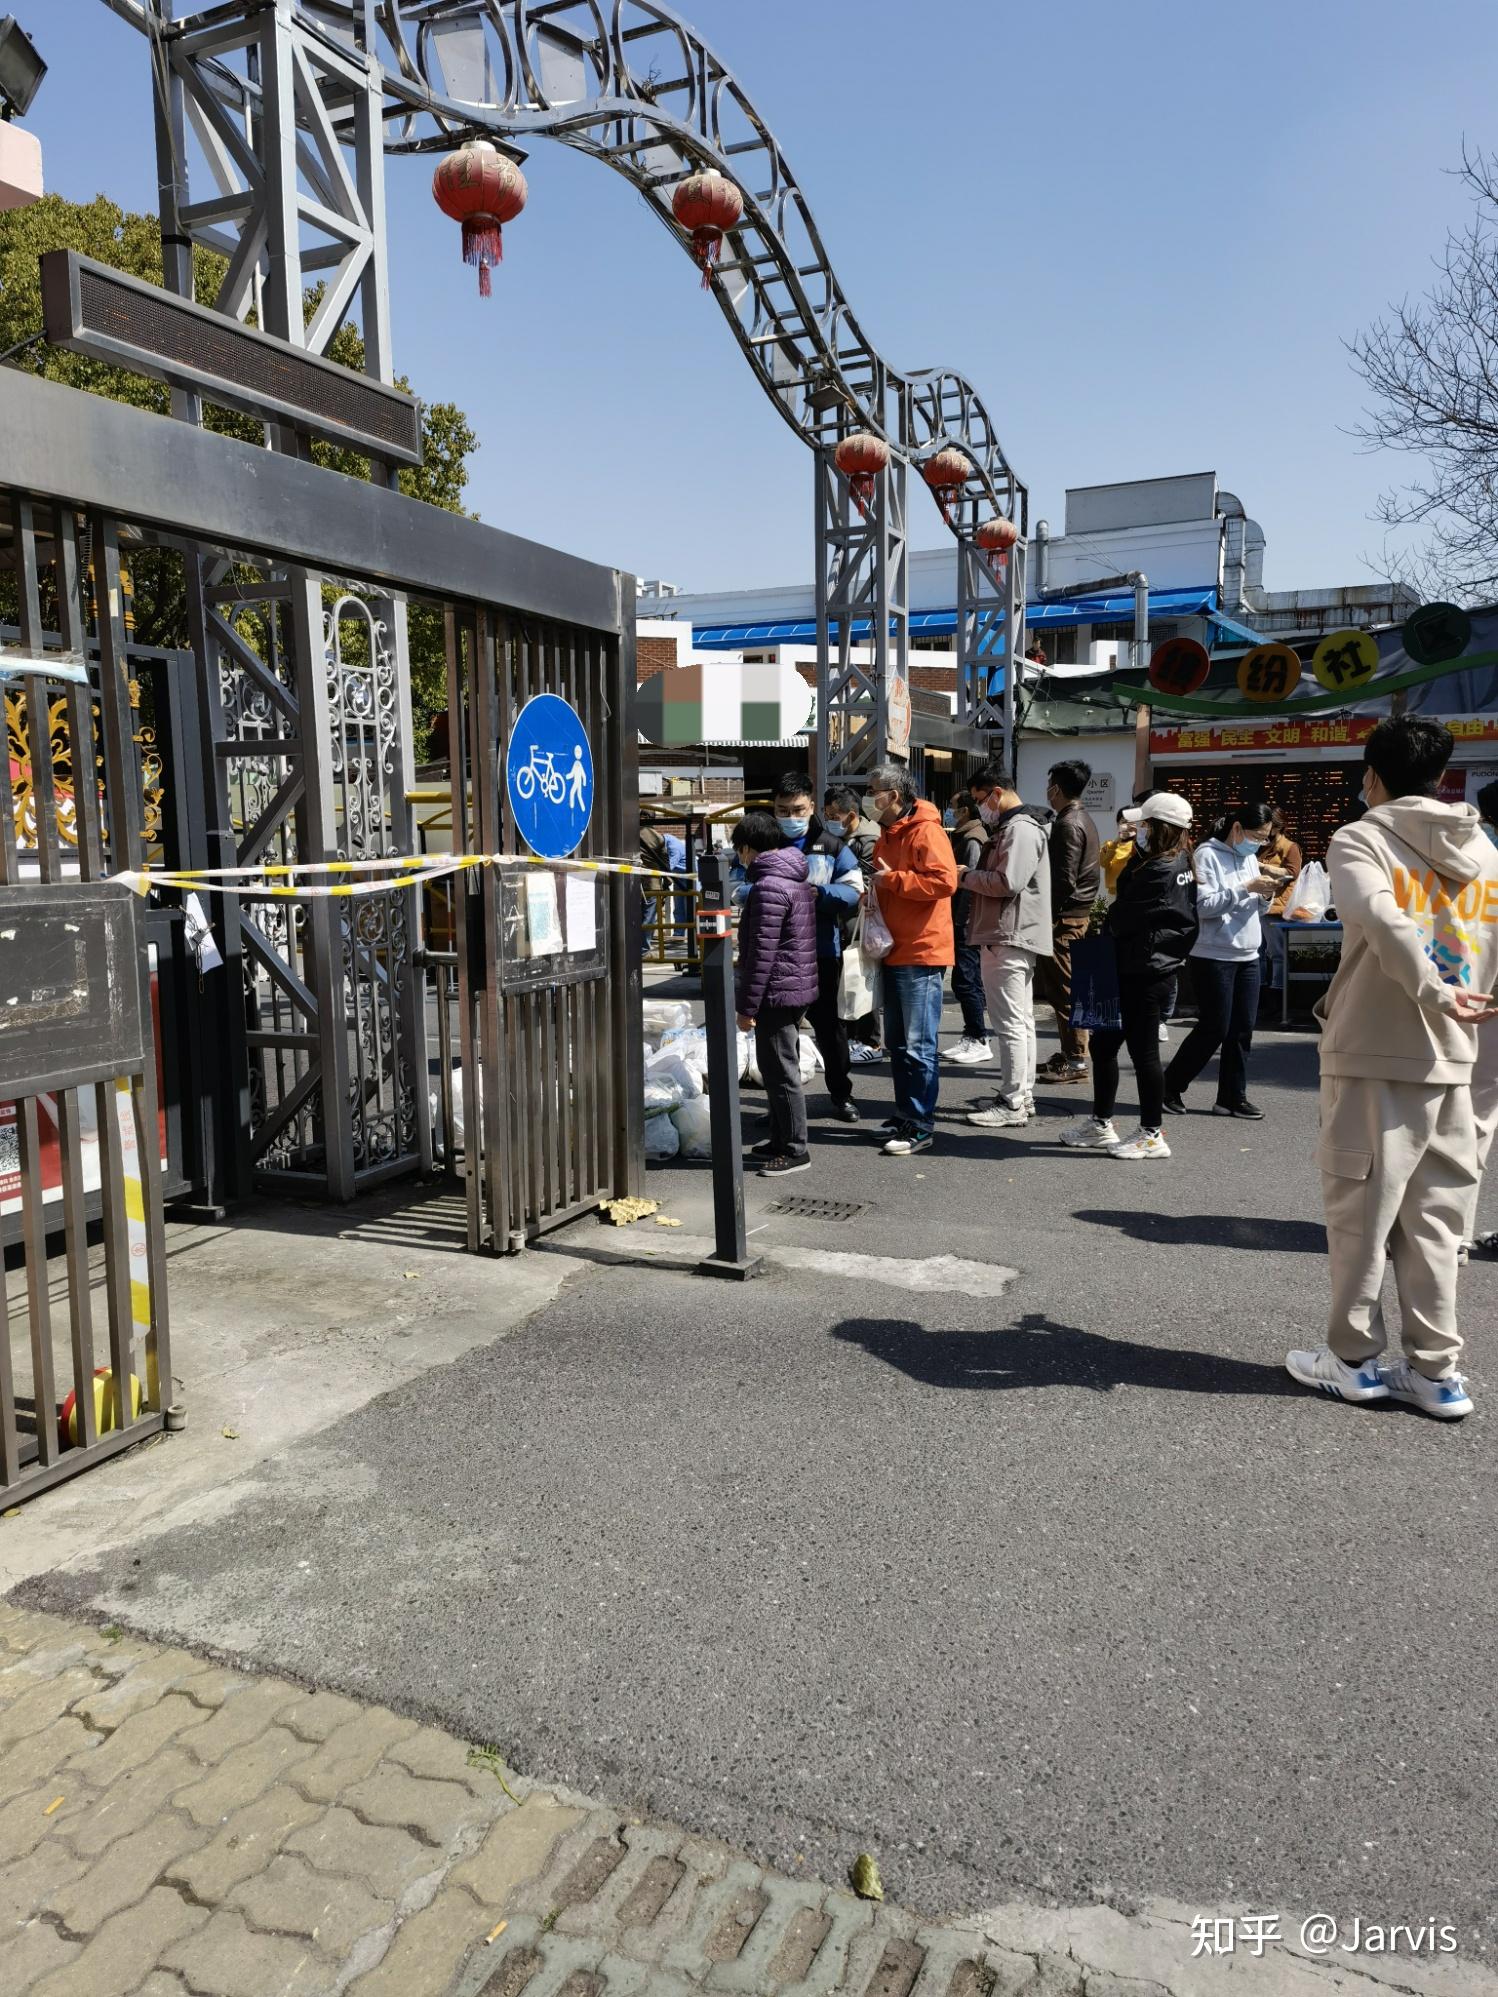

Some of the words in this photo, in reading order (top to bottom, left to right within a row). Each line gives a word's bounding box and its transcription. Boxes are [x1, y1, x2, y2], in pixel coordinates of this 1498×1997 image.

[1178, 732, 1210, 748] 富强
[1221, 729, 1254, 746] 民主
[1265, 727, 1300, 744] 文明
[1311, 726, 1348, 742] 和谐
[1446, 720, 1484, 736] 自由
